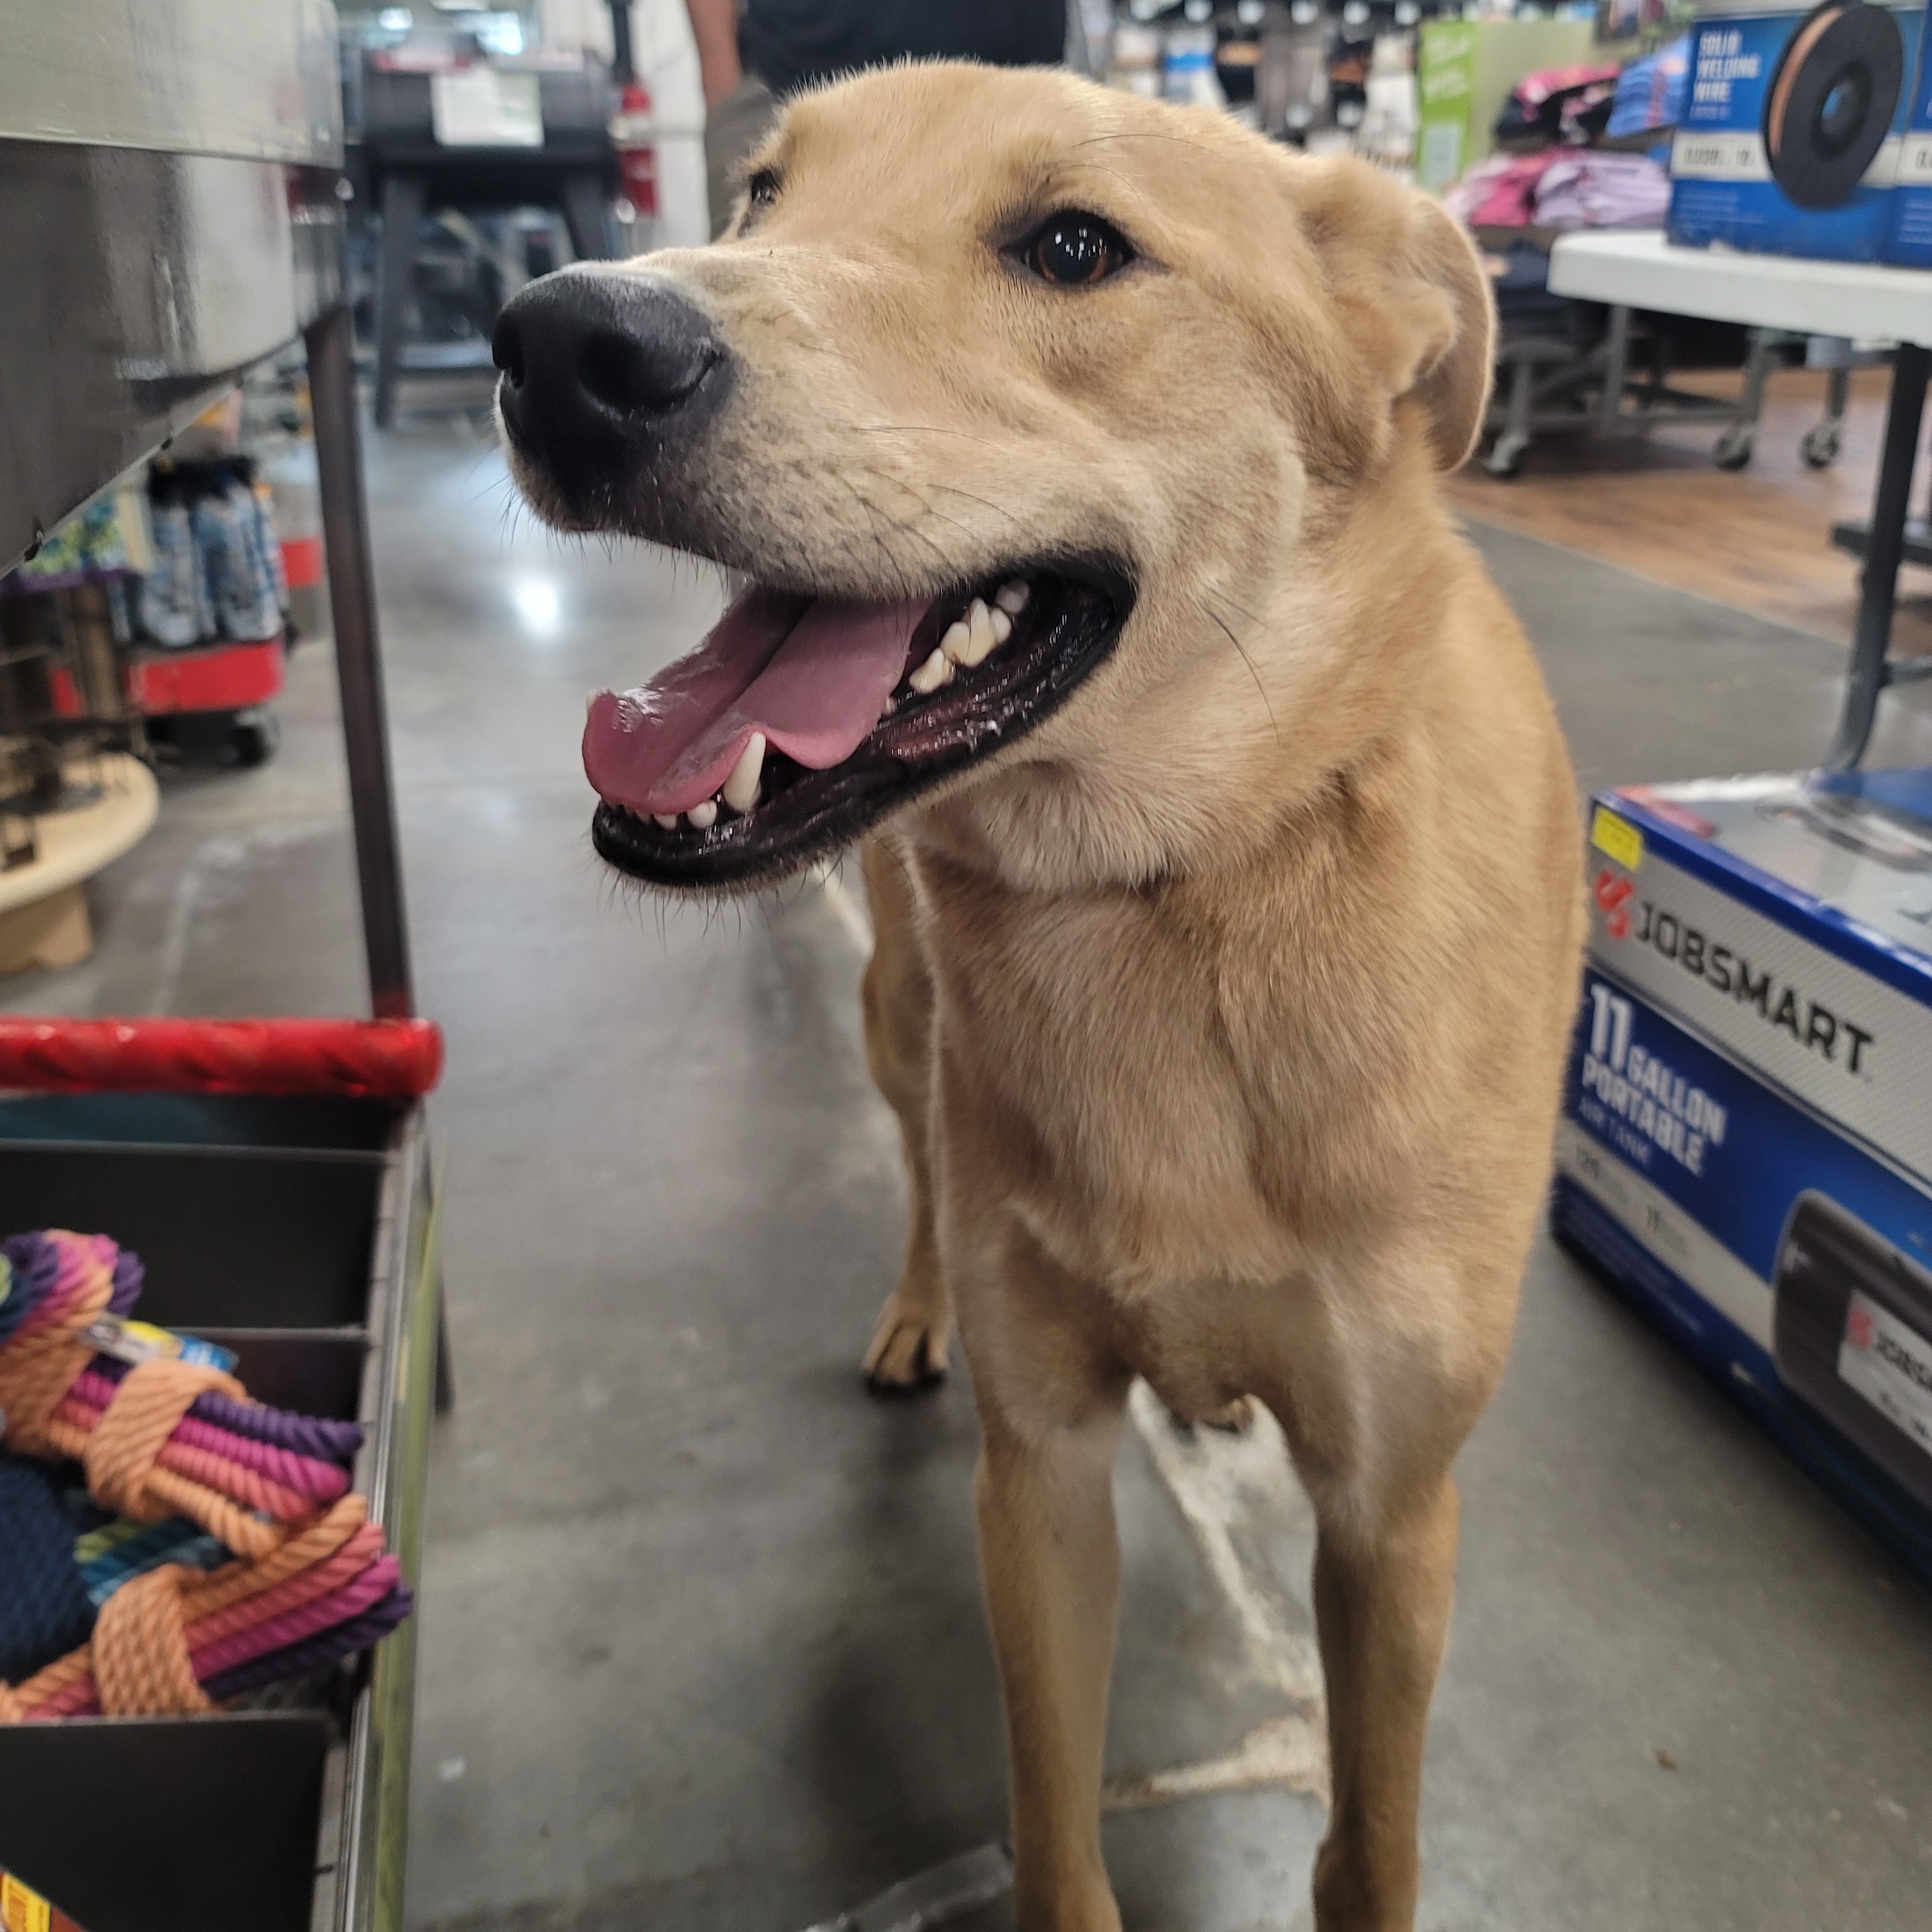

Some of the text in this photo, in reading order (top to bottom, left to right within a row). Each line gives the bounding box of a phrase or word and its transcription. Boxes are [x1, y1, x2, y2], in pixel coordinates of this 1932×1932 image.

[1692, 80, 1732, 103] WIRE
[1696, 53, 1761, 80] WELDING
[1634, 900, 1873, 1075] JOBSMART
[1582, 1052, 1705, 1177] PORTABLE
[1590, 983, 1632, 1072] 11
[1627, 1045, 1727, 1146] GALLON
